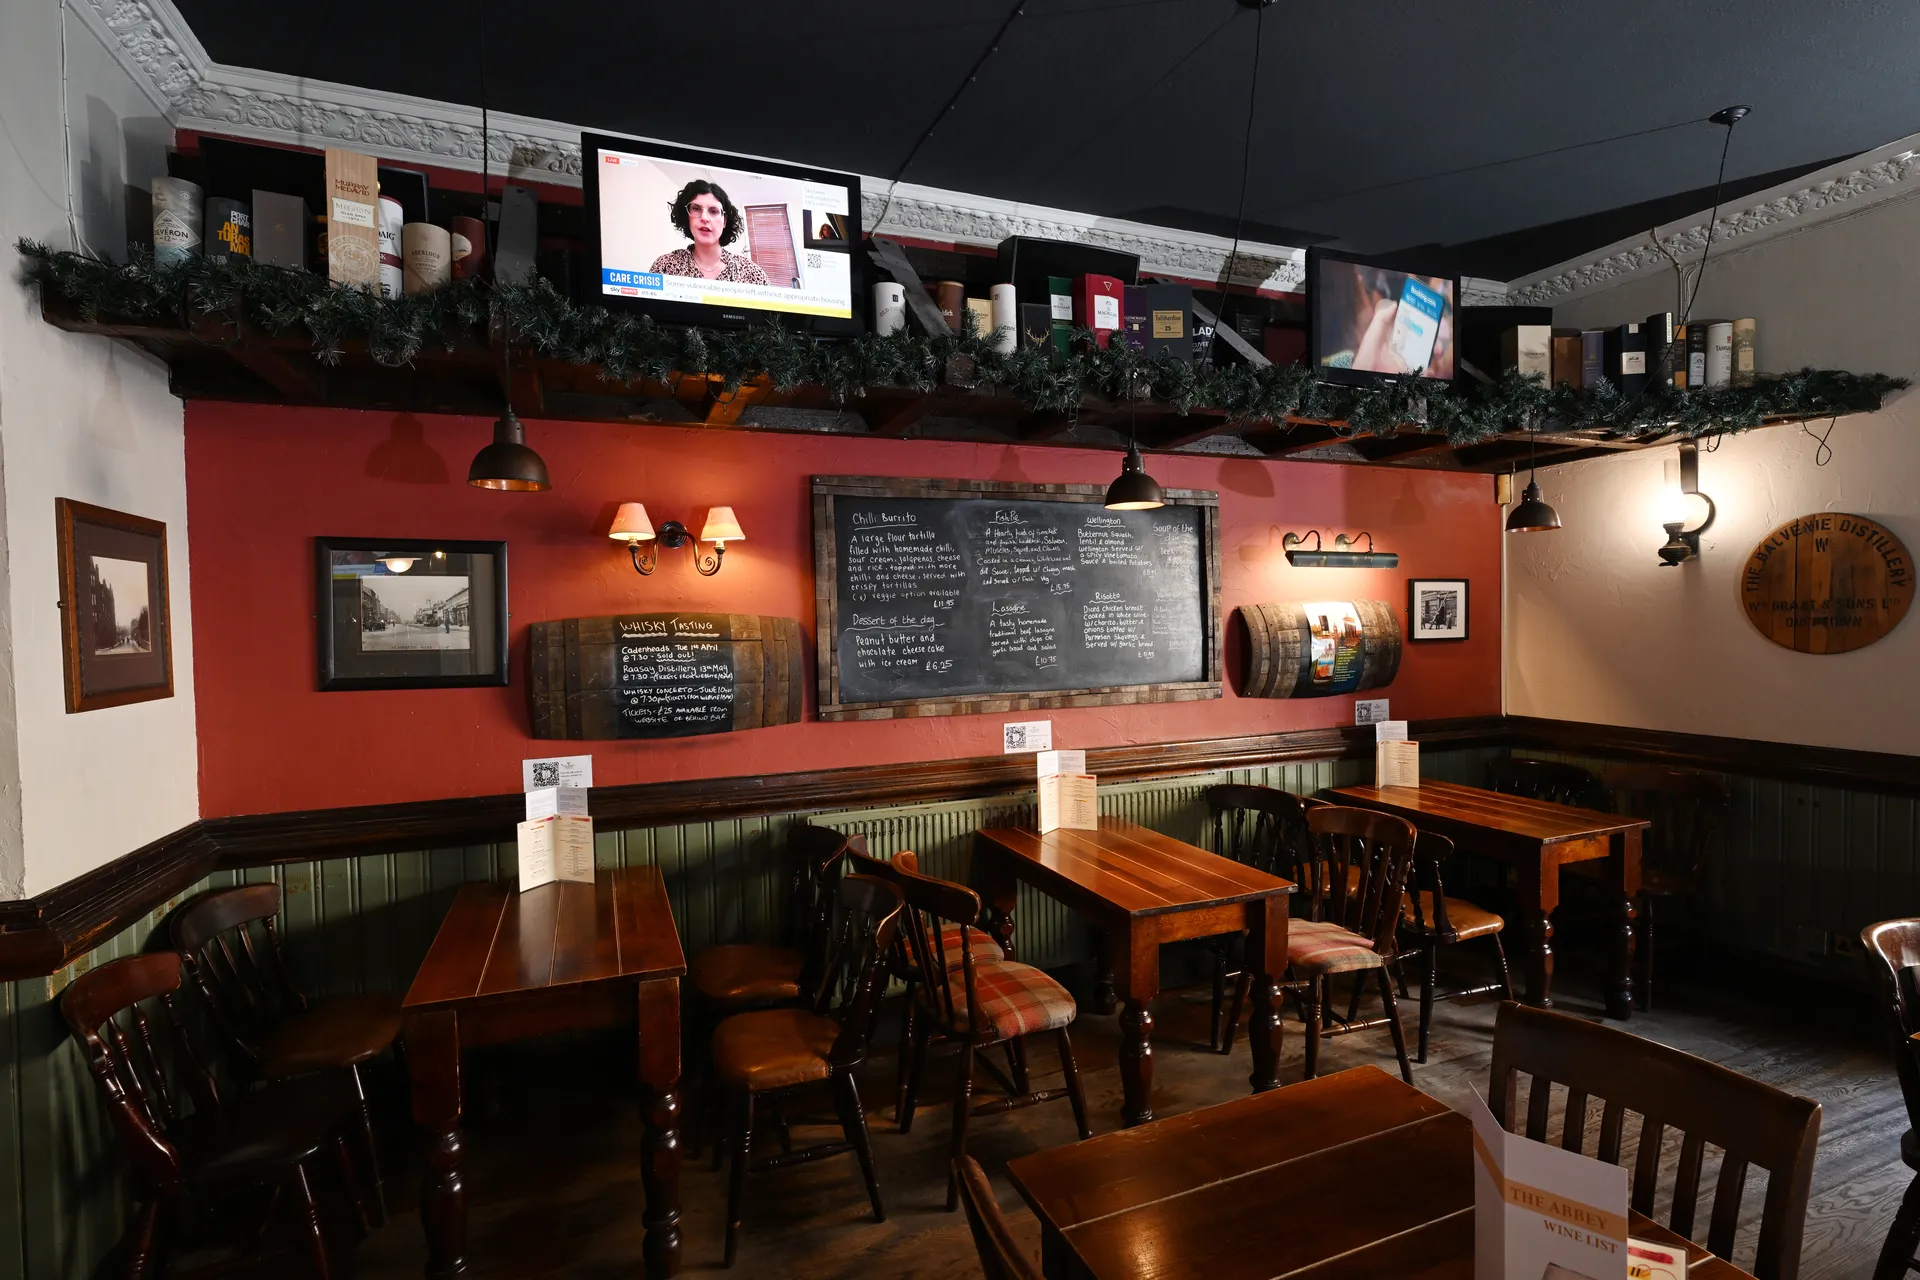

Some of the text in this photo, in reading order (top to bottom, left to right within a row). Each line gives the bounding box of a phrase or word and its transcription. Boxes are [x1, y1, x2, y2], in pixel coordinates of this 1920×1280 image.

[335, 178, 370, 191] MURRAY
[231, 210, 249, 221] PORT
[610, 272, 661, 287] CARE CRISIS
[620, 287, 638, 295] news
[853, 512, 917, 525] Chilli Burrito
[1077, 528, 1109, 538] Butternut
[1152, 522, 1194, 533] Soup of the
[851, 530, 936, 547] A large flour tortilla
[1079, 538, 1125, 546] lentil almond
[849, 545, 869, 555] filled
[873, 546, 891, 554] with
[895, 544, 933, 553] homemade
[849, 554, 961, 564] sour cheese
[1747, 518, 1906, 593] THE BALVENIE DISTILLERY
[890, 564, 915, 572] topped
[850, 570, 966, 582] chilli and served with
[851, 579, 918, 592] crispy tortillas
[872, 588, 960, 602] veggie option available
[1095, 591, 1121, 601] Risotto
[993, 602, 1026, 614] Lasagne
[1084, 605, 1100, 614] Diced
[1124, 604, 1144, 612] breast
[1772, 600, 1817, 612] GRANT
[1838, 598, 1875, 610] SONS
[620, 617, 713, 632] WHISKY TASTING
[852, 613, 935, 632] Dessert of the day
[990, 619, 996, 628] A
[1018, 618, 1048, 626] homemade
[1119, 618, 1138, 626] butter
[1020, 627, 1032, 636] beef
[1083, 626, 1105, 634] onions
[855, 633, 936, 646] Peanut butter and
[991, 638, 1010, 647] served
[1013, 636, 1027, 644] with
[621, 645, 670, 655] Cadenheads
[700, 643, 719, 651] April
[857, 646, 896, 657] chocolate
[1009, 643, 1024, 652] bread
[622, 655, 630, 663] @
[634, 653, 649, 661] 7.30
[657, 652, 674, 660] Sold
[859, 658, 918, 669] with ice cream
[623, 665, 655, 675] Raasay
[658, 665, 697, 676] Distillery
[713, 664, 729, 674] May
[622, 673, 649, 681] @ 7.30
[623, 686, 718, 696] WHISKY CONCERTO JUNE
[630, 697, 639, 705] @
[622, 708, 652, 717] TICKETS
[675, 705, 707, 714] AVAILABLE
[710, 705, 728, 713] FROM
[635, 716, 668, 724] WEBSITE
[711, 713, 727, 722] BAR
[1510, 1186, 1608, 1230] THE ABBEY
[1543, 1219, 1619, 1254] WINE LIST
